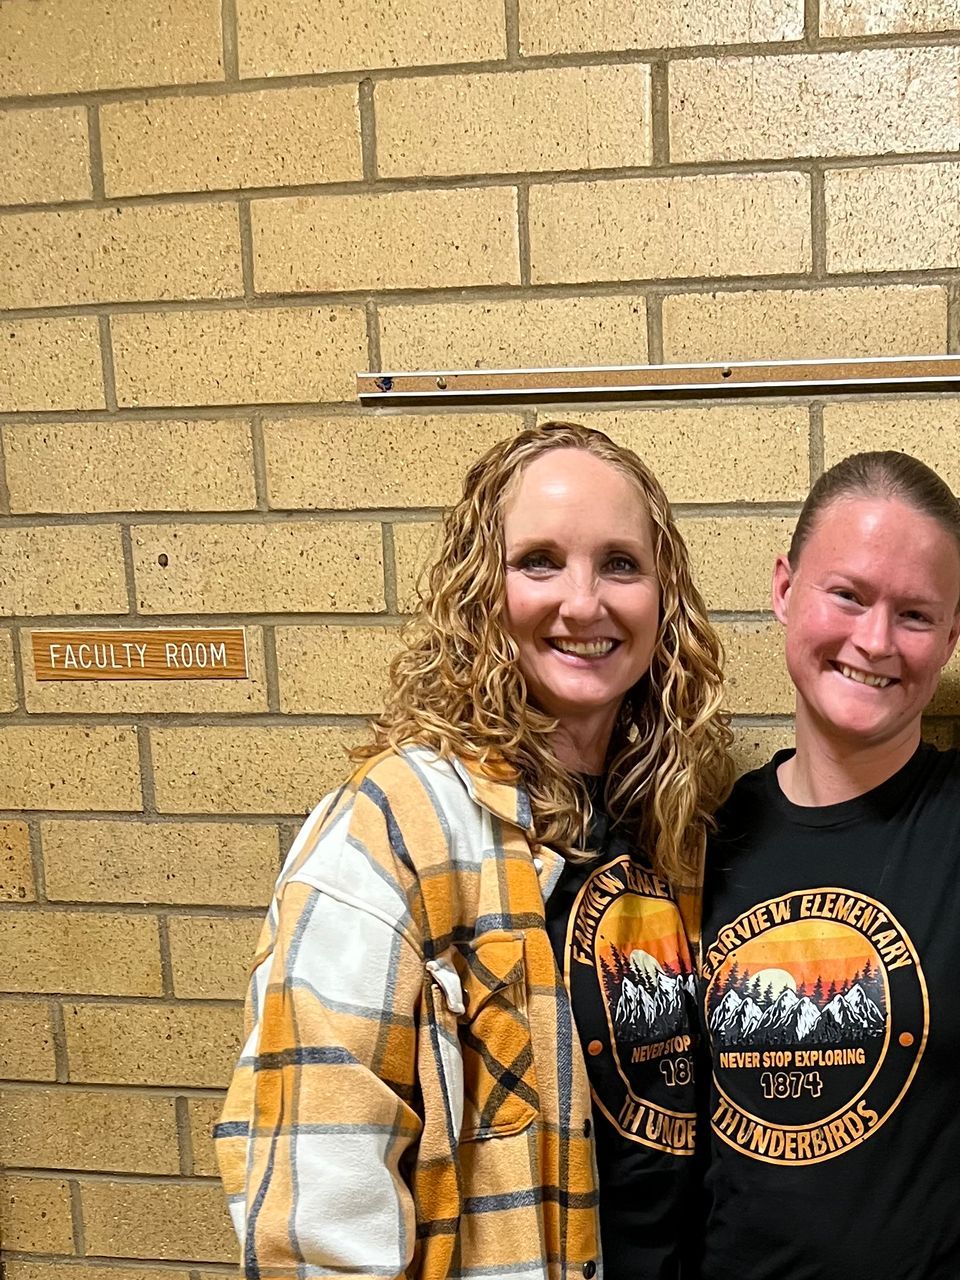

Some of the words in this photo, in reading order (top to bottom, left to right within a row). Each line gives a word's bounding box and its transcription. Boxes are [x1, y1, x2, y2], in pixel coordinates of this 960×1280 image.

[49, 643, 147, 669] FACULTY
[165, 642, 227, 668] ROOM
[702, 898, 792, 981] FAIRVIEW
[800, 894, 912, 972] ELEMENTARY
[631, 1041, 665, 1063] NEVER
[664, 1034, 691, 1055] STOP
[720, 1052, 760, 1069] NEVER
[762, 1051, 792, 1068] STOP
[794, 1048, 866, 1067] EXPLORING
[760, 1071, 823, 1099] 1874
[711, 1097, 879, 1160] THUNDERBIRDS
